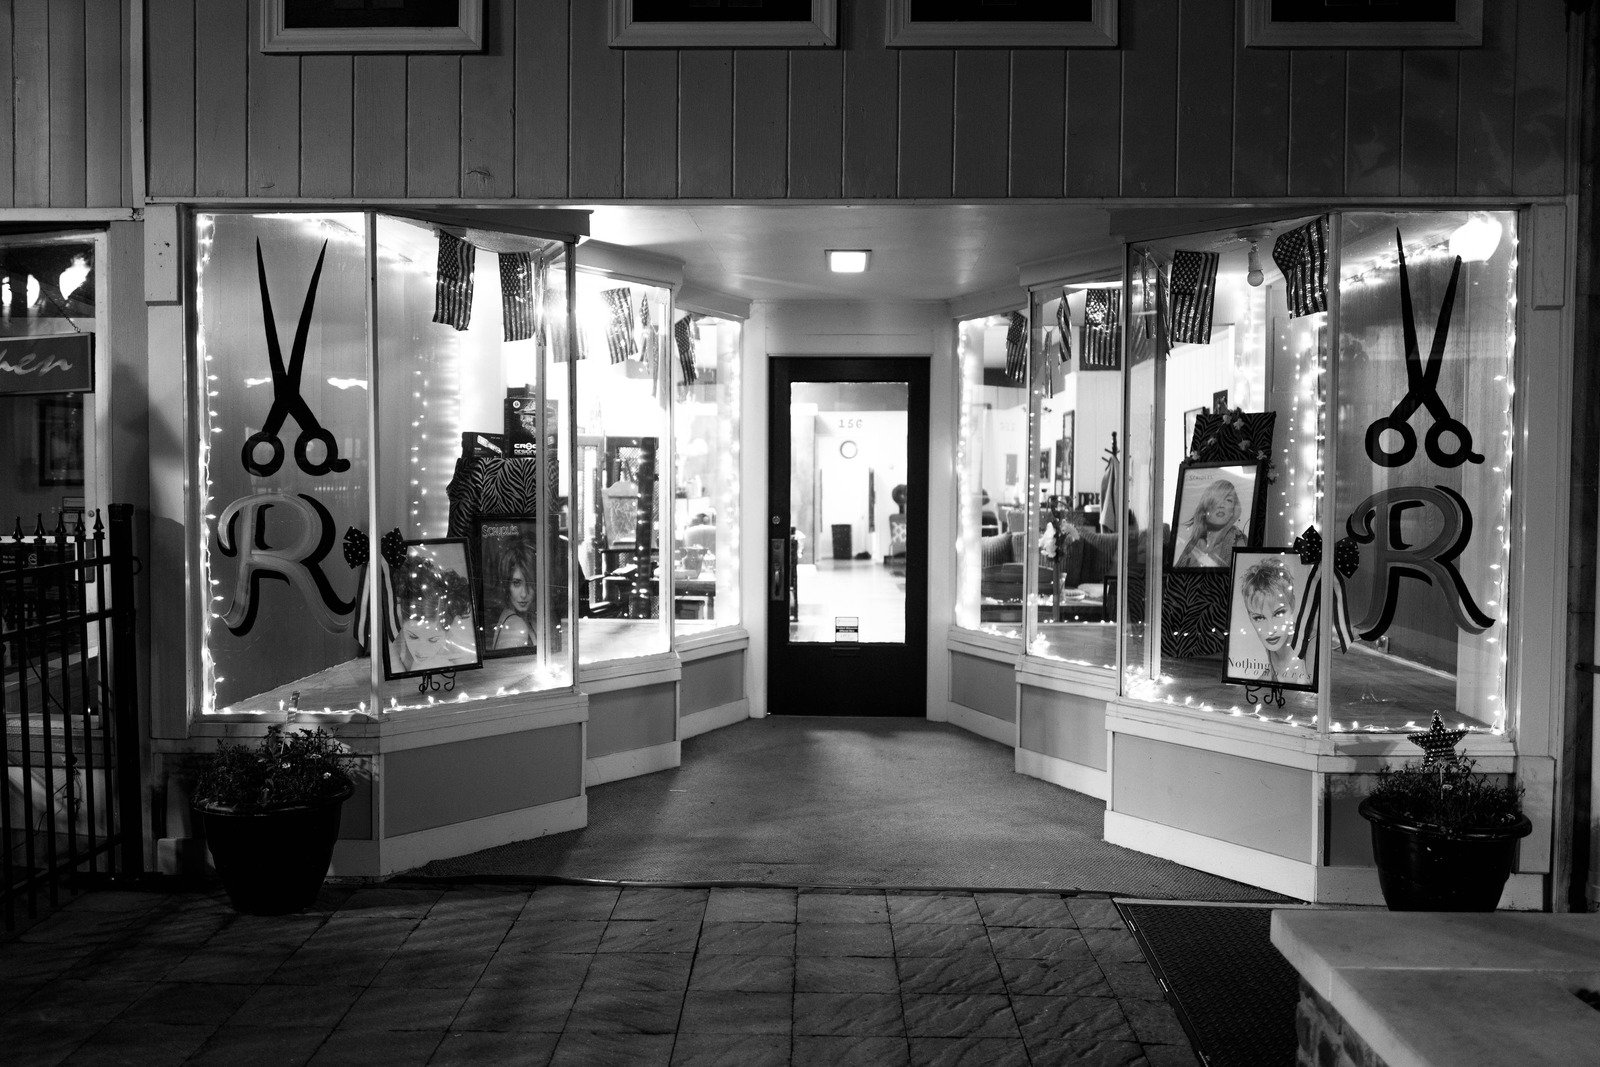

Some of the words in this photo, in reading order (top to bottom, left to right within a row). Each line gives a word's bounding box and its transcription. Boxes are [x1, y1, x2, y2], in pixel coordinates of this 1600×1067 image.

[838, 418, 863, 429] 156
[216, 492, 356, 637] R
[1346, 485, 1496, 642] R
[1228, 656, 1270, 671] Nothing
